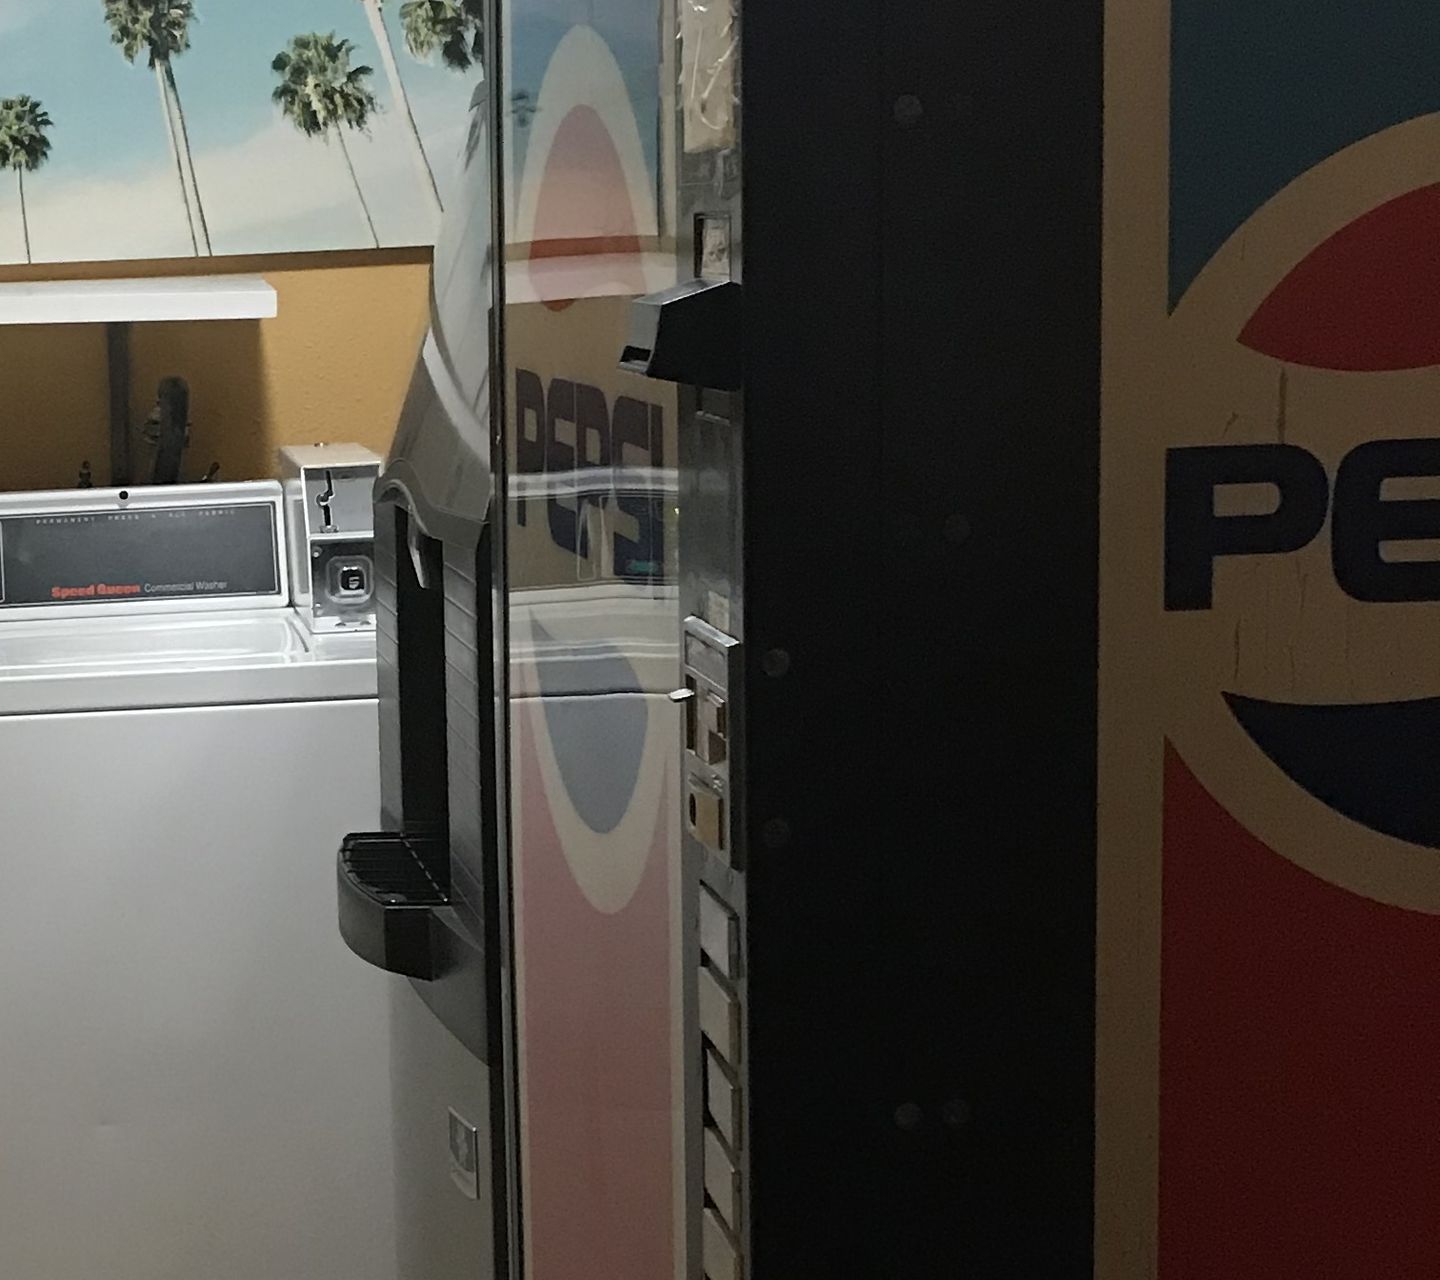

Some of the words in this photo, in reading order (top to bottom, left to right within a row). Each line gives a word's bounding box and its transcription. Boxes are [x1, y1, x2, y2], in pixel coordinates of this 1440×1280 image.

[516, 368, 664, 578] PEPSI
[51, 585, 95, 598] Speed
[97, 583, 140, 595] Queen
[144, 581, 194, 593] Commercial
[196, 580, 227, 591] Washer
